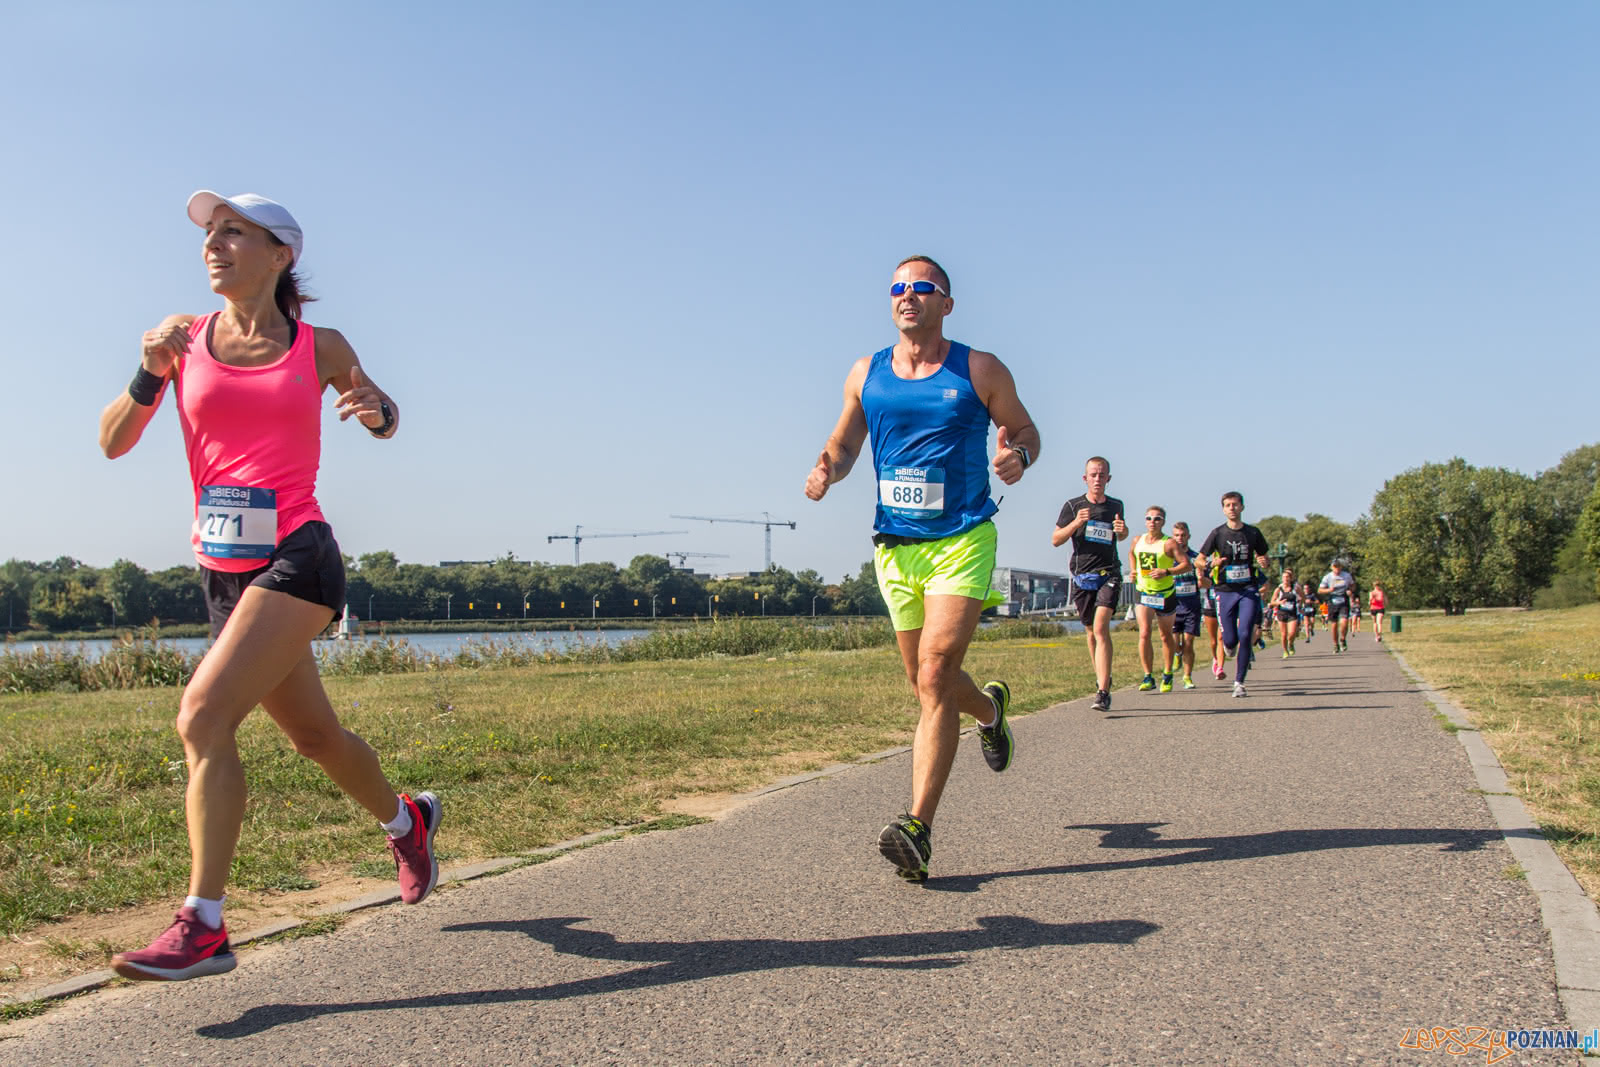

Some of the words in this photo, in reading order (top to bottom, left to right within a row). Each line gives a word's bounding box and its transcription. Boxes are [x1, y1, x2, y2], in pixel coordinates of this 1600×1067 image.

[893, 486, 923, 504] 688
[208, 513, 243, 537] 271
[1093, 529, 1107, 537] 703
